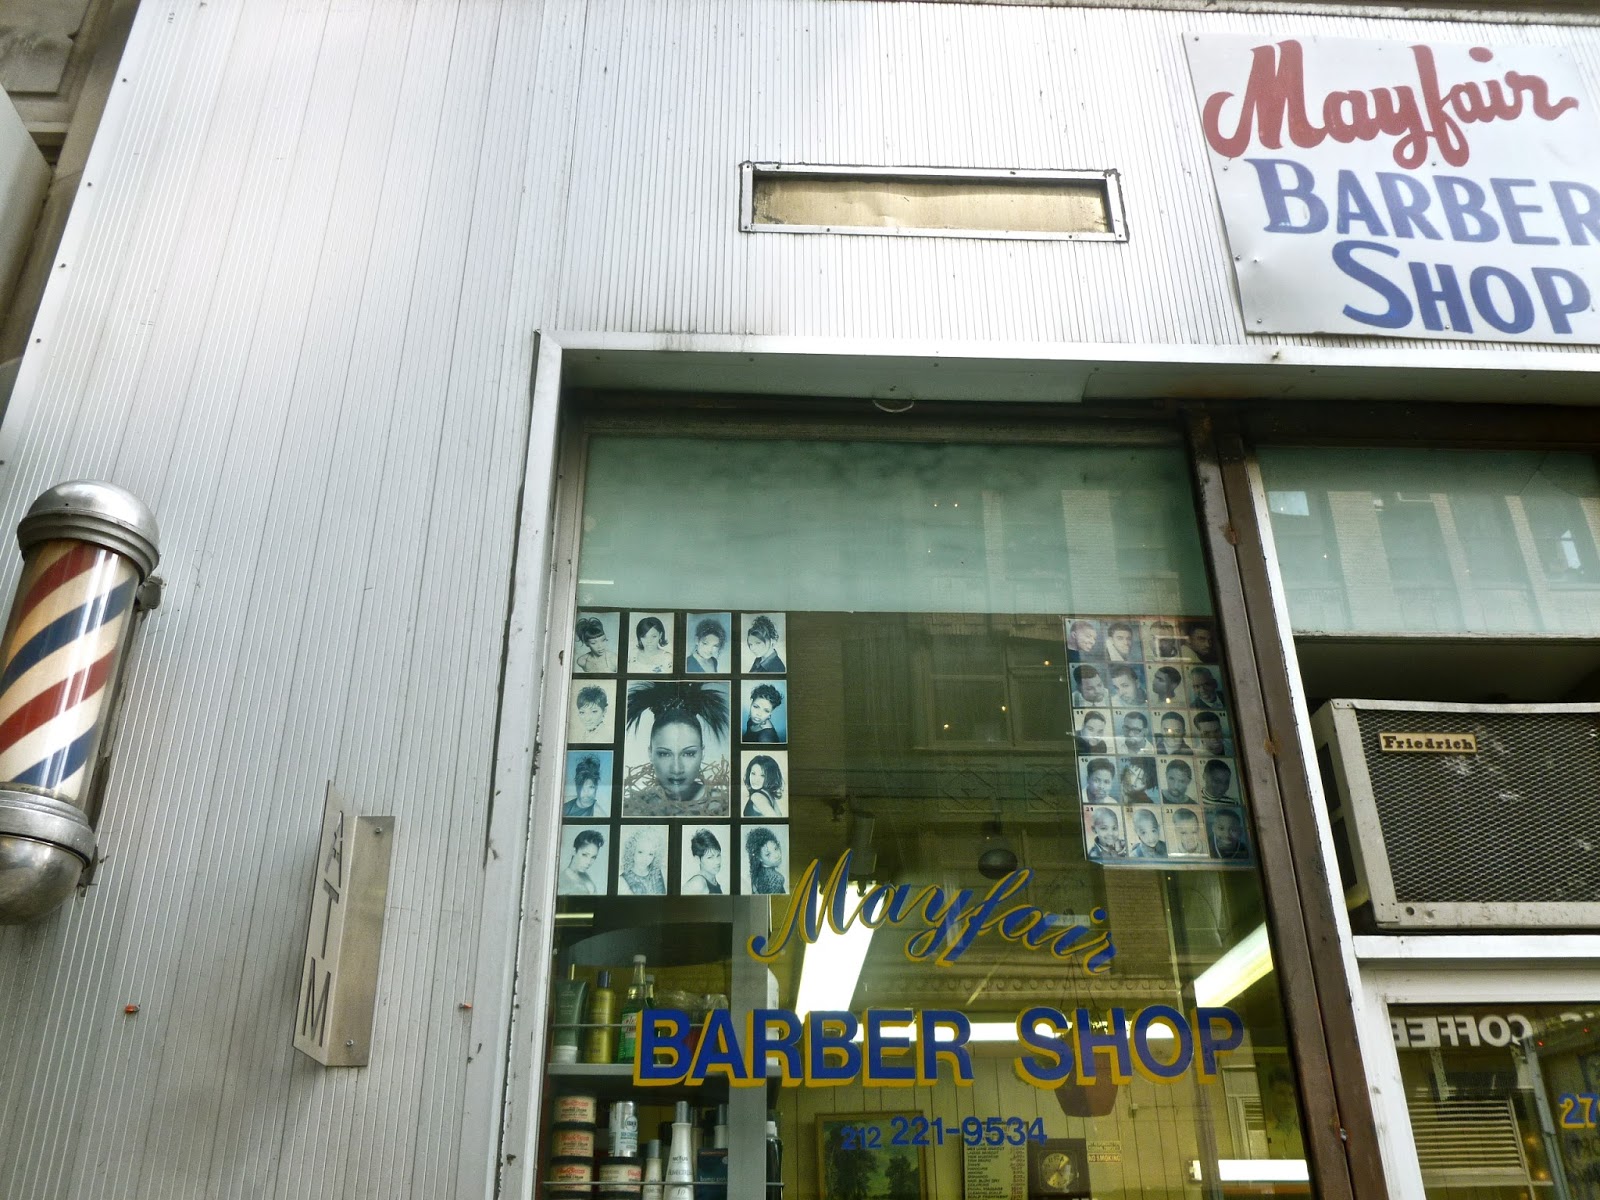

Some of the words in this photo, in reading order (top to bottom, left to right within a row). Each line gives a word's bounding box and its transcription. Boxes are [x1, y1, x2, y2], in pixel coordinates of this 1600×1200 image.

[1202, 39, 1580, 170] Mayfair
[1244, 158, 1600, 246] BARBER
[1331, 240, 1591, 334] SHOP
[1382, 735, 1474, 750] Friedrich
[747, 848, 1118, 976] Mayfair
[633, 1008, 975, 1088] BARBER
[1014, 1006, 1245, 1090] SHOP
[841, 1126, 882, 1150] 212
[891, 1116, 1048, 1147] 221-9534
[1558, 1092, 1600, 1129] 27
